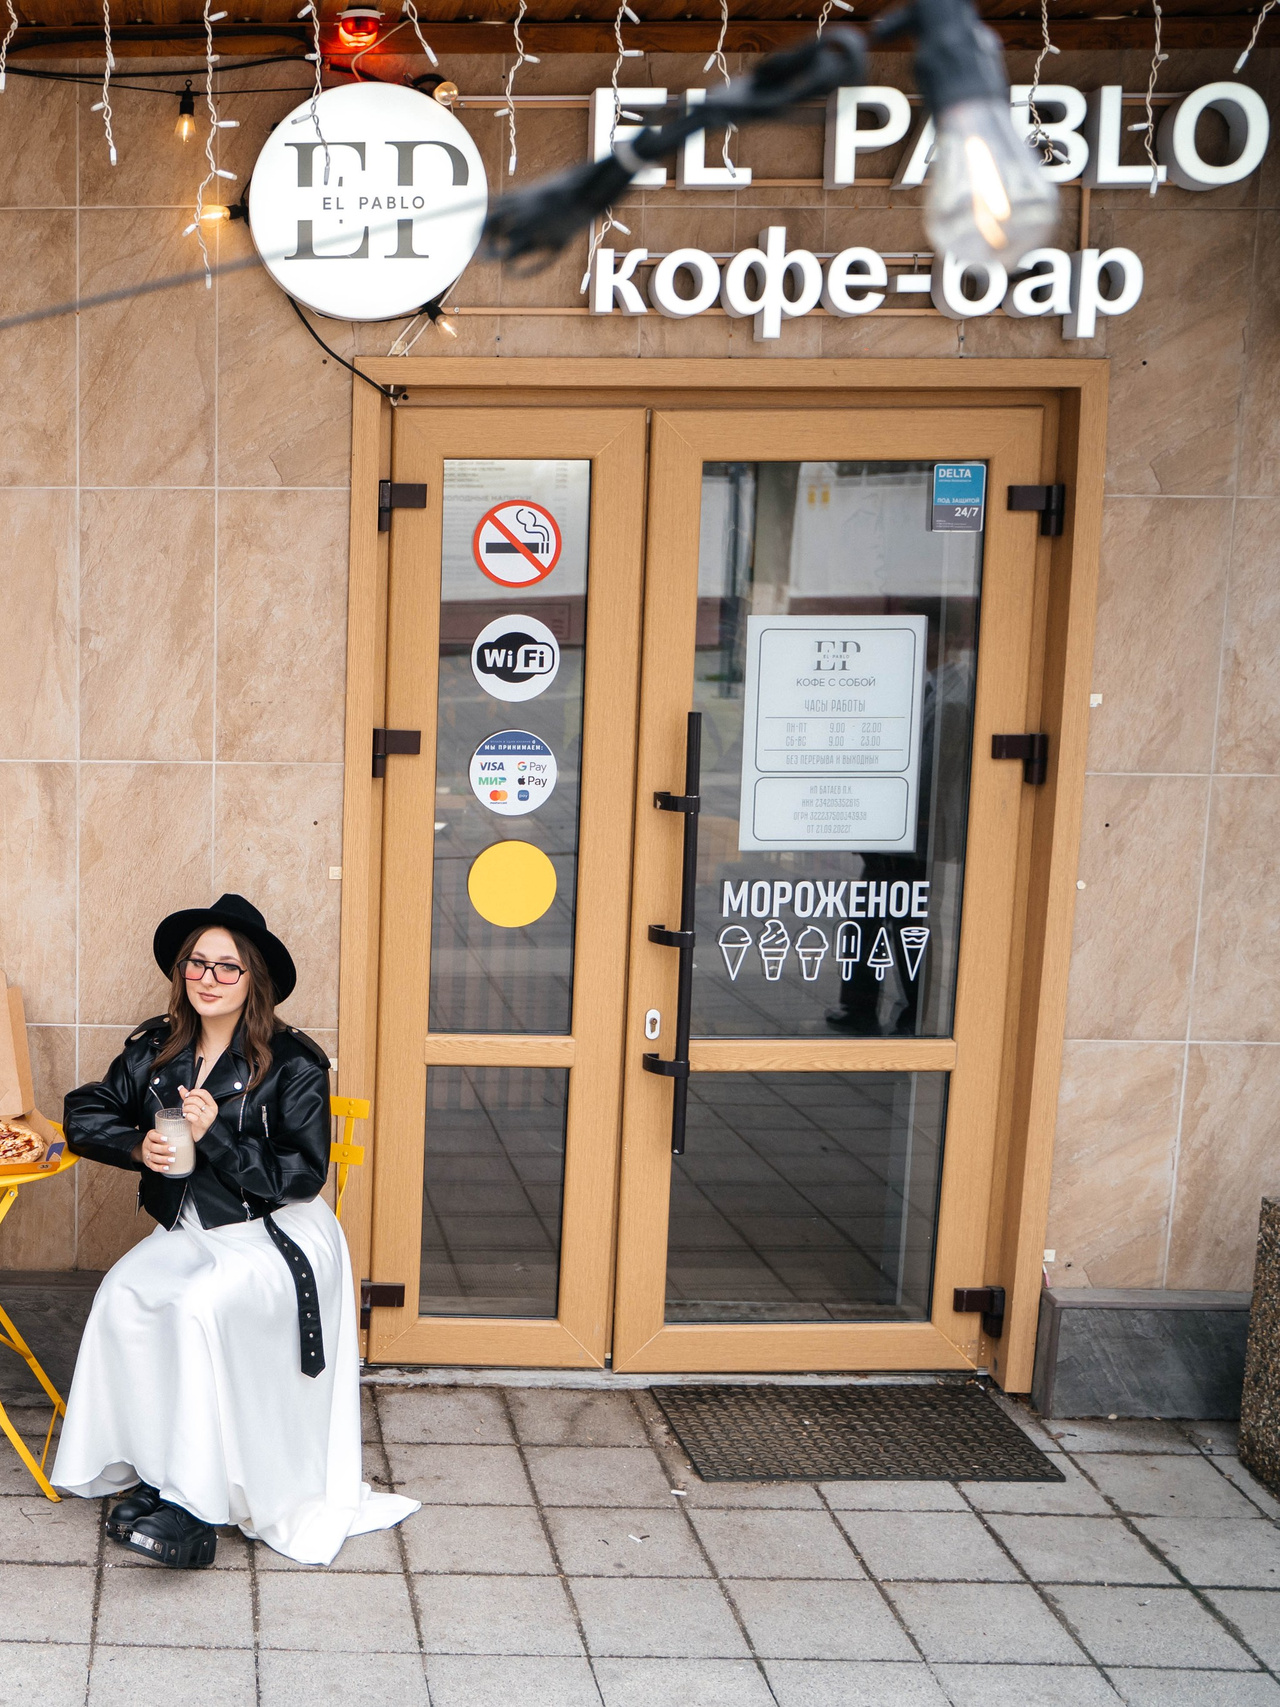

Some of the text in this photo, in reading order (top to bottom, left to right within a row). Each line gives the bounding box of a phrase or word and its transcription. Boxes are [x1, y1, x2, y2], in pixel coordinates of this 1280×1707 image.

[593, 87, 753, 187] EL
[322, 195, 426, 210] EL PABLO
[593, 226, 1144, 340] кофе-бар
[938, 468, 972, 478] DELTA
[954, 506, 979, 518] 24/7
[796, 676, 876, 687] КОФЕ С СОБОЙ
[804, 699, 866, 712] ЧАСЫ РАБОТЫ
[786, 722, 807, 733] ПН-ПТ
[829, 722, 846, 733] 9.00
[861, 722, 882, 733] 22.00
[785, 736, 807, 747] СБ-ВС
[828, 736, 844, 747] 9.00
[860, 735, 881, 747] 23.00
[480, 761, 505, 771] VISA
[785, 754, 799, 765] БЕЗ
[800, 754, 834, 765] ПЕРЕРЫВА
[842, 754, 880, 766] ВЫХОДНЫХ
[529, 762, 548, 774] Pay
[478, 776, 507, 786] МИР
[527, 775, 548, 788] Pay
[722, 880, 931, 918] МОРОЖЕНОЕ
